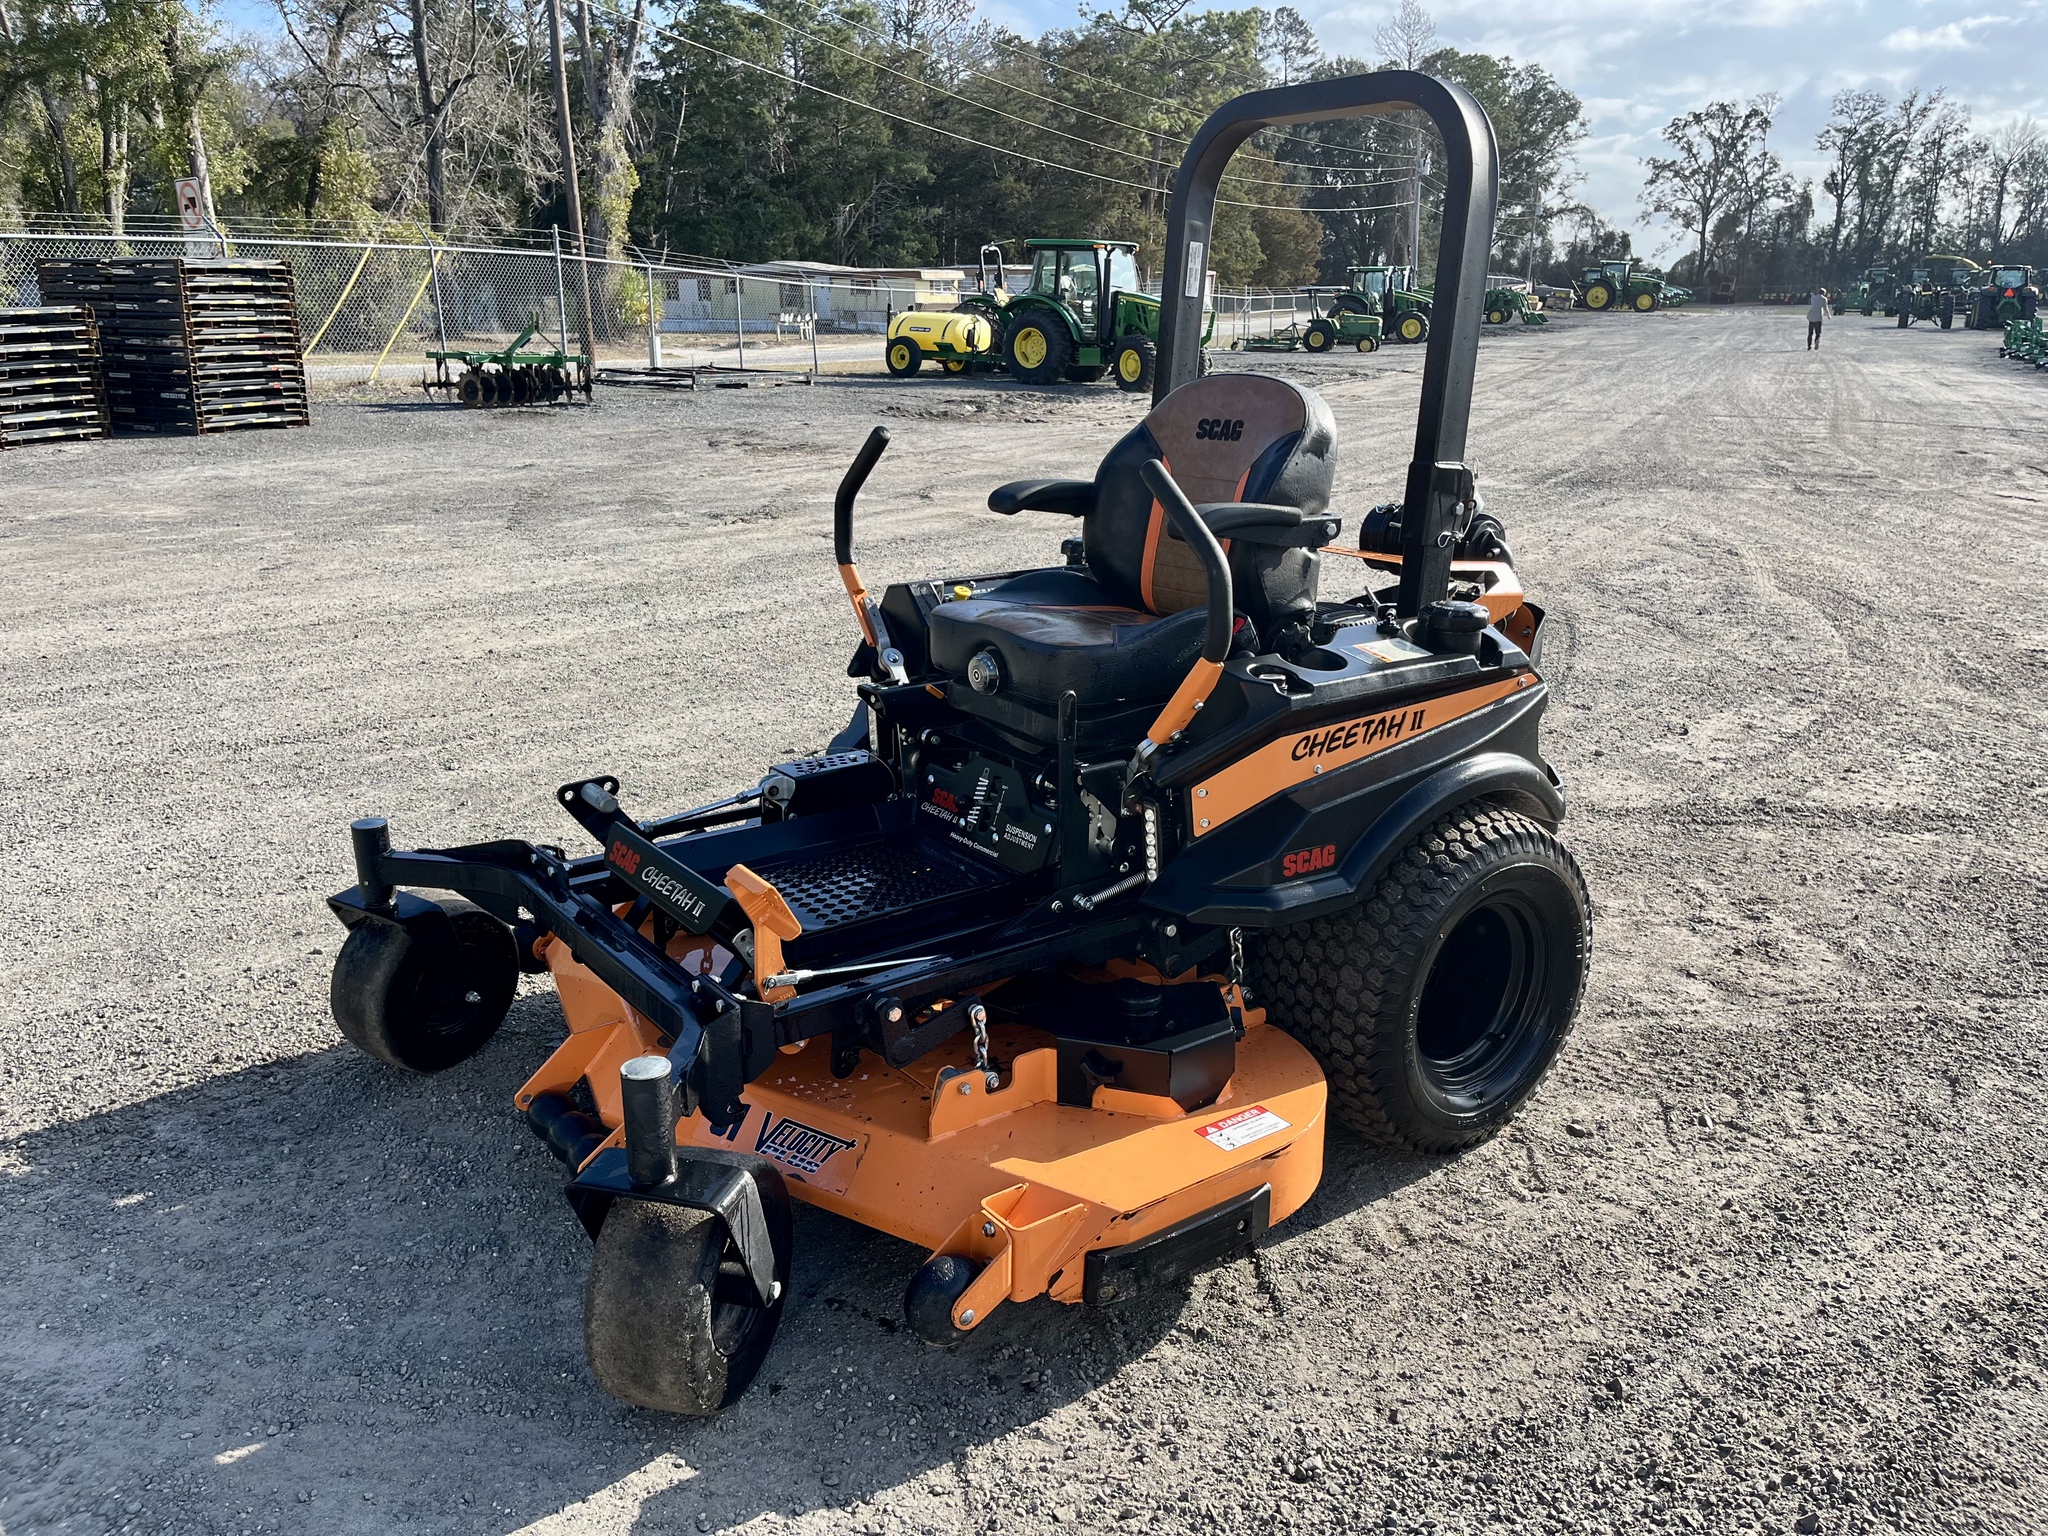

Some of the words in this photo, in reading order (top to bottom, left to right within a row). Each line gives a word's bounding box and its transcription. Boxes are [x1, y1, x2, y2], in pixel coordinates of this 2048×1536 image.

[1195, 418, 1245, 442] SCAG
[1291, 710, 1408, 761] CHEETAH
[1409, 709, 1426, 732] II
[921, 802, 955, 823] CHEETAH
[932, 788, 959, 813] SCA
[1003, 832, 1035, 851] ADJUSTMENT
[1005, 823, 1038, 844] SUSPENSION
[973, 842, 1000, 858] Commercial
[1283, 844, 1336, 877] SCAG
[609, 840, 641, 875] SCAG
[641, 866, 698, 912] CHEETAH
[692, 900, 706, 918] II
[1217, 1109, 1261, 1128] DANGER
[754, 1111, 858, 1165] VELOCITY
[759, 1143, 823, 1175] PLUS
